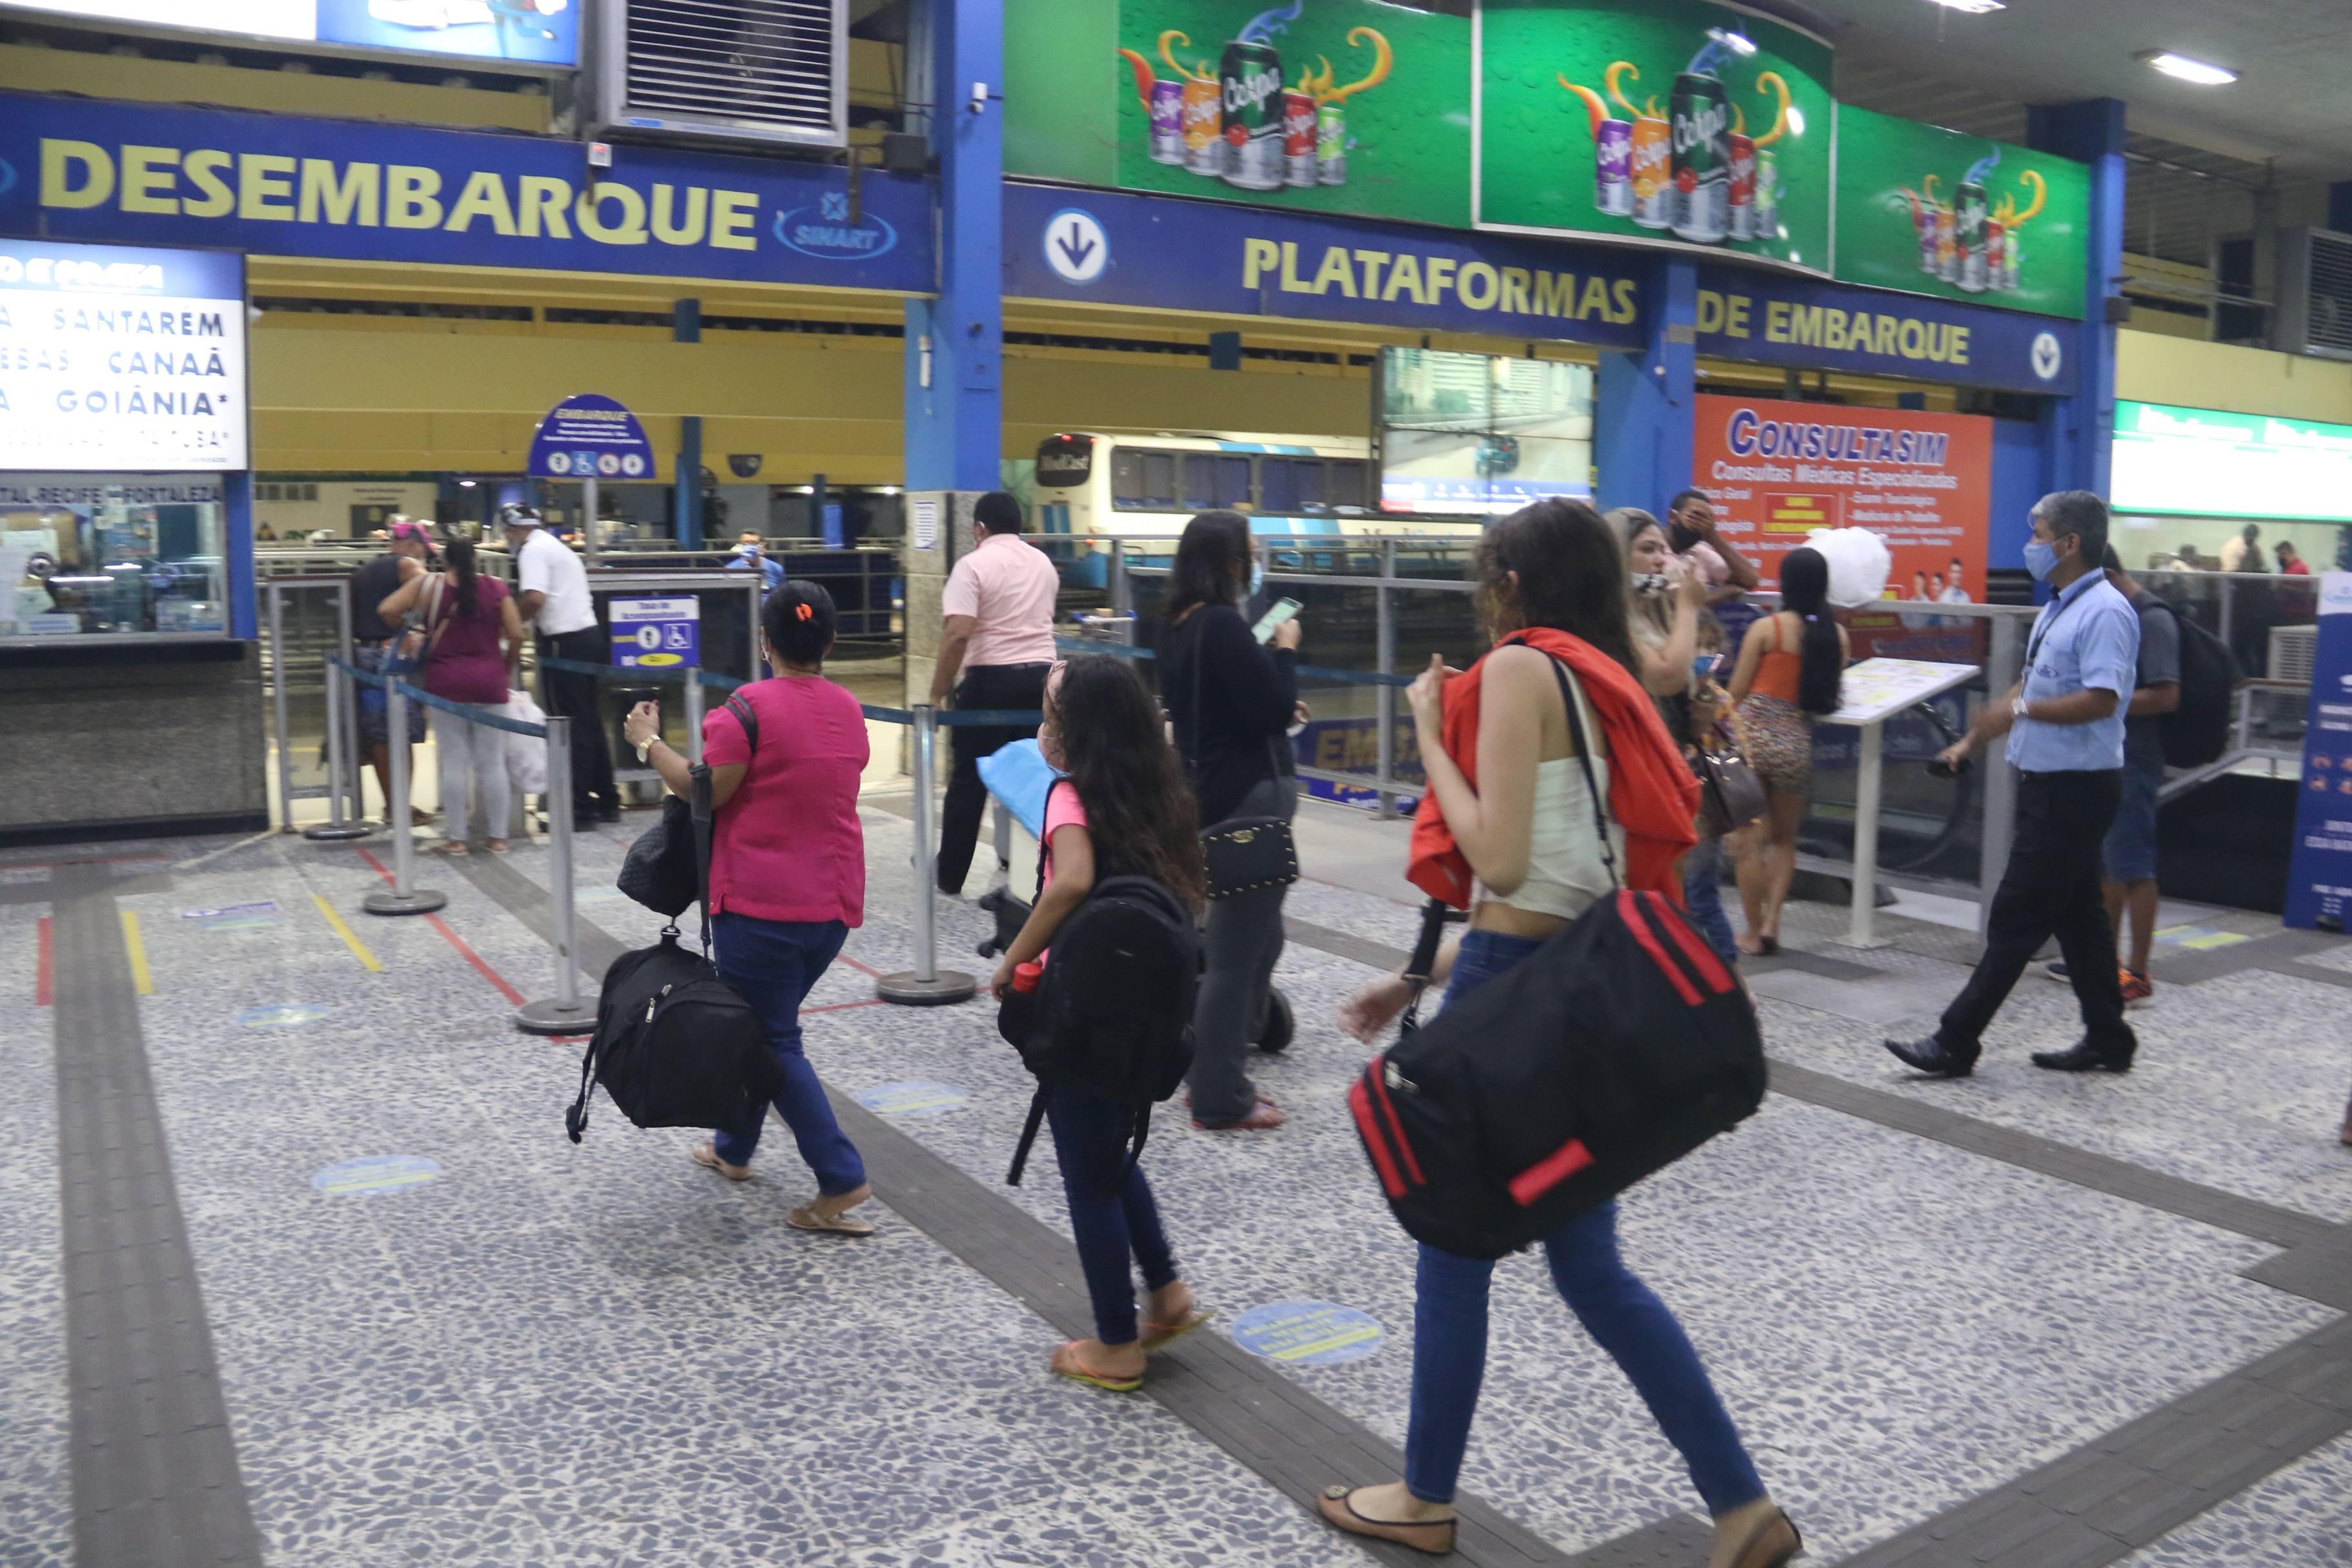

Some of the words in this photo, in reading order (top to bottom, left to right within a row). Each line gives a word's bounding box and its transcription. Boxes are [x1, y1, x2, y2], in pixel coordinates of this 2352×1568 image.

[39, 137, 760, 251] DESEMBARQUE
[794, 222, 879, 250] SINART
[1242, 237, 1637, 324] PLATAFORMAS
[54, 306, 224, 337] SANTARÉM
[1696, 289, 1752, 339] DE
[1765, 300, 1970, 366] EMBARQUE
[108, 347, 226, 377] CANAÃ
[1712, 460, 1792, 482] Consultas
[1857, 466, 1959, 490] Especializadas
